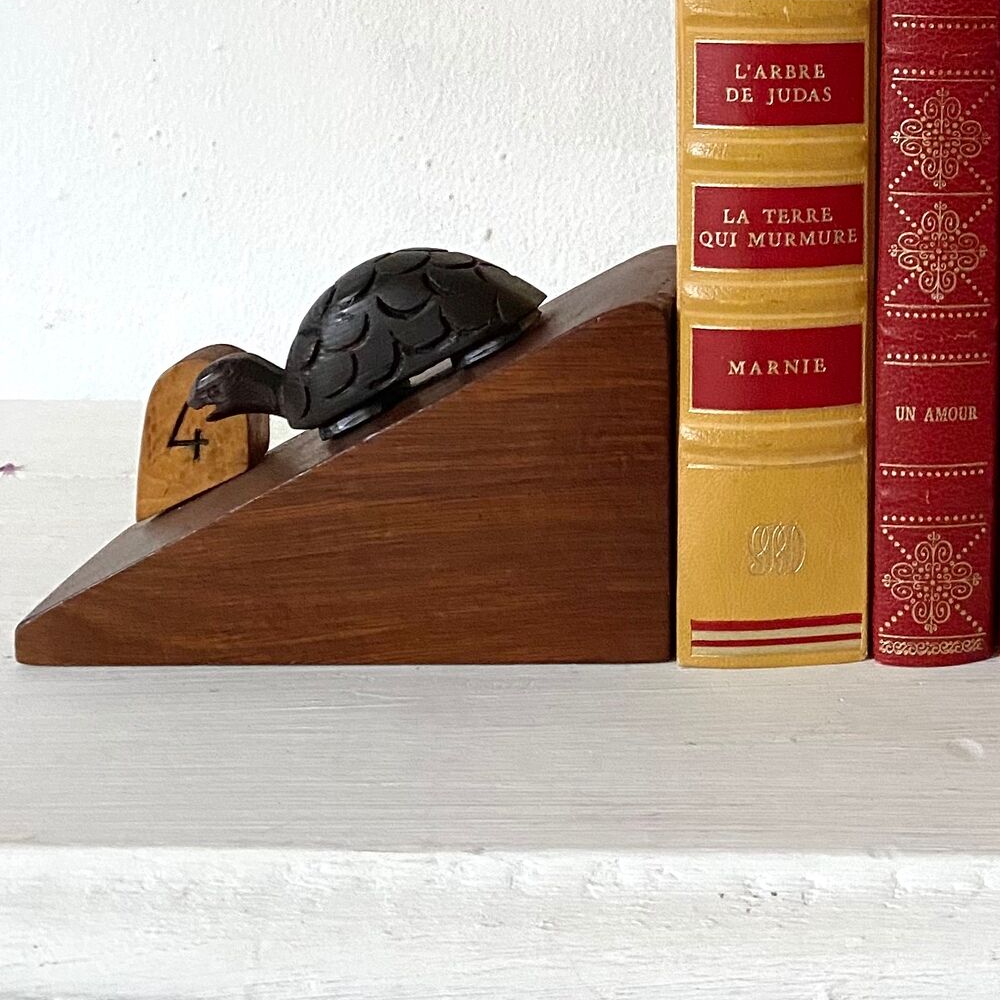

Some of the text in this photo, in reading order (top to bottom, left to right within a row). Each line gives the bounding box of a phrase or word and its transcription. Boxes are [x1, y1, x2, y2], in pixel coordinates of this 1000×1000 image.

[735, 64, 825, 80] L'ARBRE
[726, 87, 832, 105] DE JUDAS
[723, 207, 833, 224] LA TERRE
[699, 228, 858, 248] QUI MURMURE
[727, 358, 827, 376] MARNIE
[895, 406, 978, 422] UN AMOUR
[166, 401, 210, 463] 4
